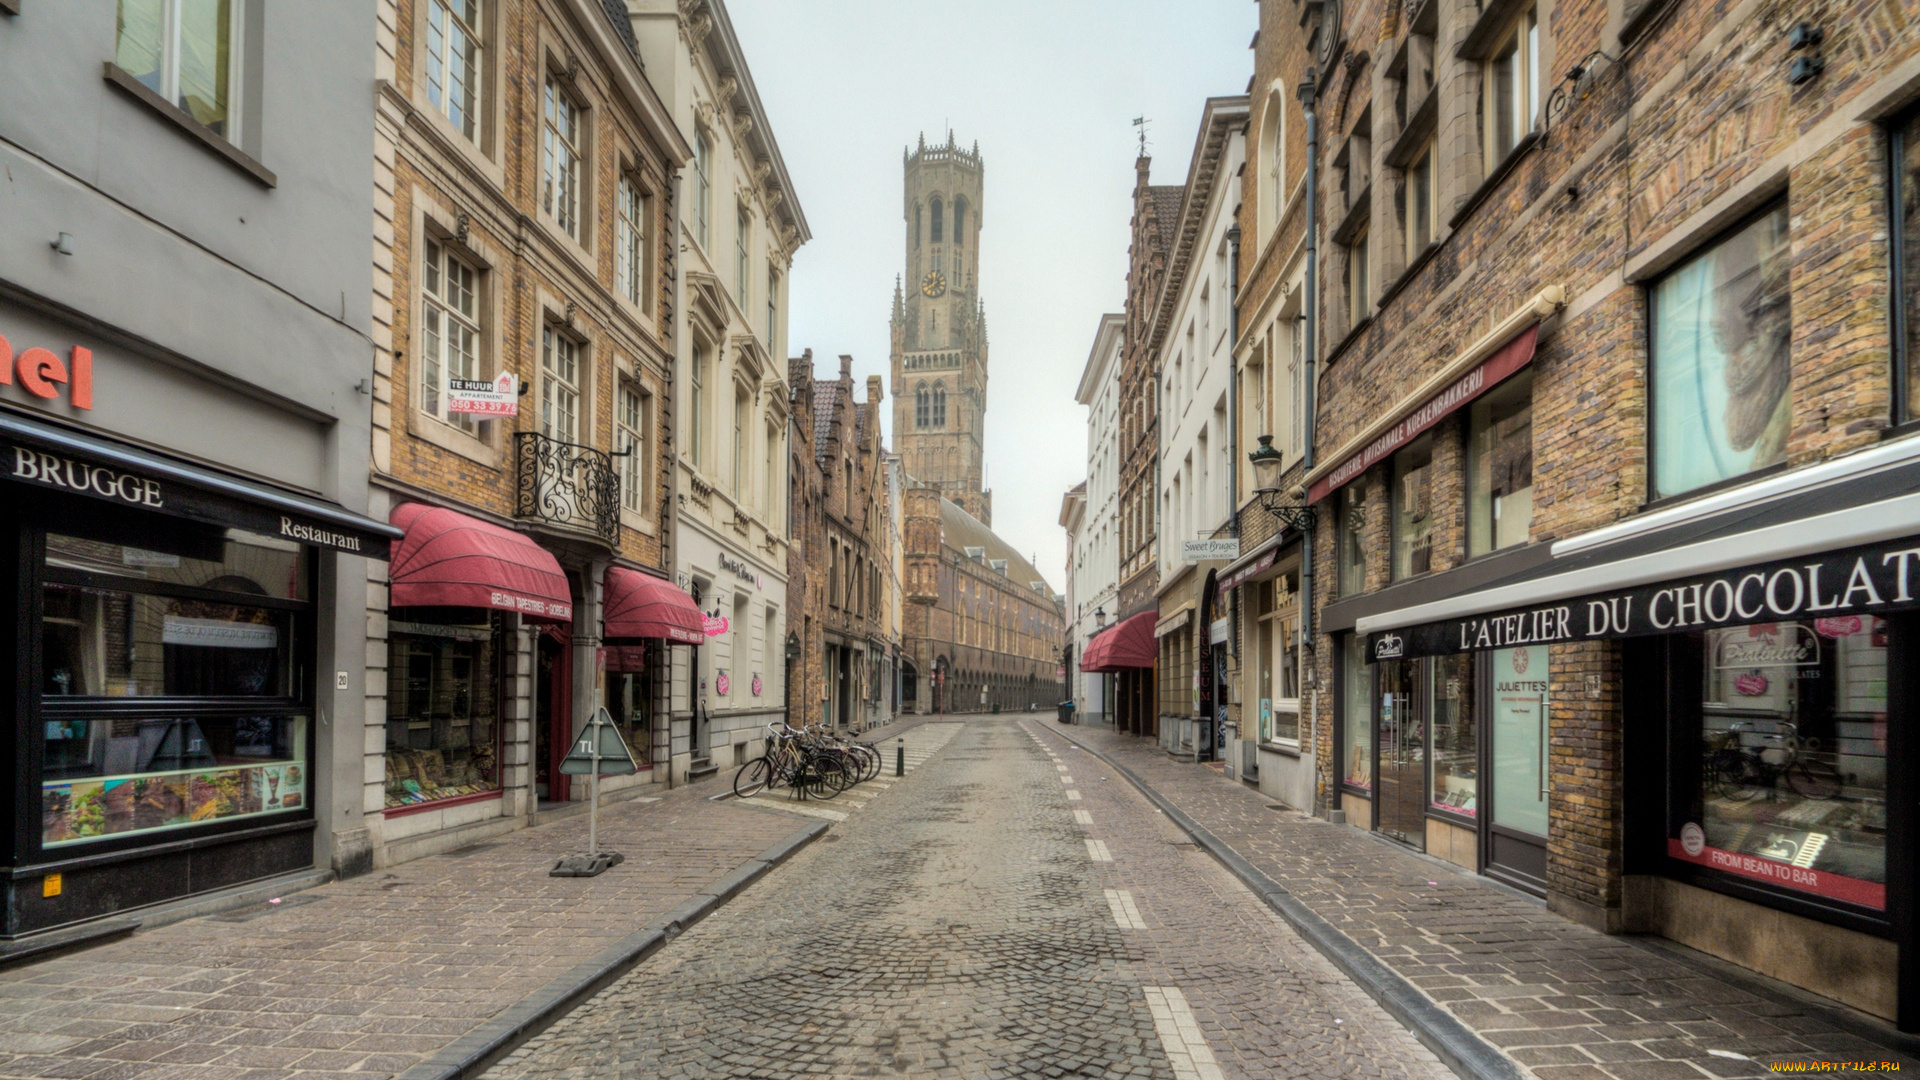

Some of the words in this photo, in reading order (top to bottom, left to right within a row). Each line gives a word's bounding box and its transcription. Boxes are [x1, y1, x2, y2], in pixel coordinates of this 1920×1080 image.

[0, 333, 93, 410] el
[452, 380, 462, 389] TE
[465, 382, 493, 391] HUUR
[451, 400, 470, 408] 050
[473, 401, 486, 410] 33
[489, 402, 501, 411] 39
[460, 392, 503, 400] APPARTEMENT
[1328, 458, 1362, 488] BISCUITERIE
[1364, 422, 1404, 468] ARTISANALE
[1406, 365, 1484, 435] KOEKENBAKKERIJ
[12, 446, 164, 508] BRUGGE
[280, 516, 361, 552] Restaurant
[1184, 542, 1208, 552] Sweet
[1209, 540, 1237, 552] Bruges
[492, 592, 515, 608] BELGIAN
[516, 597, 544, 613] TAPESTRIES
[549, 604, 571, 618] GOBELINS
[1460, 605, 1570, 651] L'ATELIER
[1588, 595, 1632, 636] DU
[1649, 549, 1920, 630] CHOCOLAT
[1200, 626, 1211, 701] MUSEUM
[339, 675, 347, 686] 20
[1496, 680, 1547, 692] JULIETTE'S
[1712, 850, 1742, 869] FROM
[1744, 857, 1773, 876] BEAN
[1774, 864, 1791, 880] TO
[1792, 869, 1818, 886] BAR
